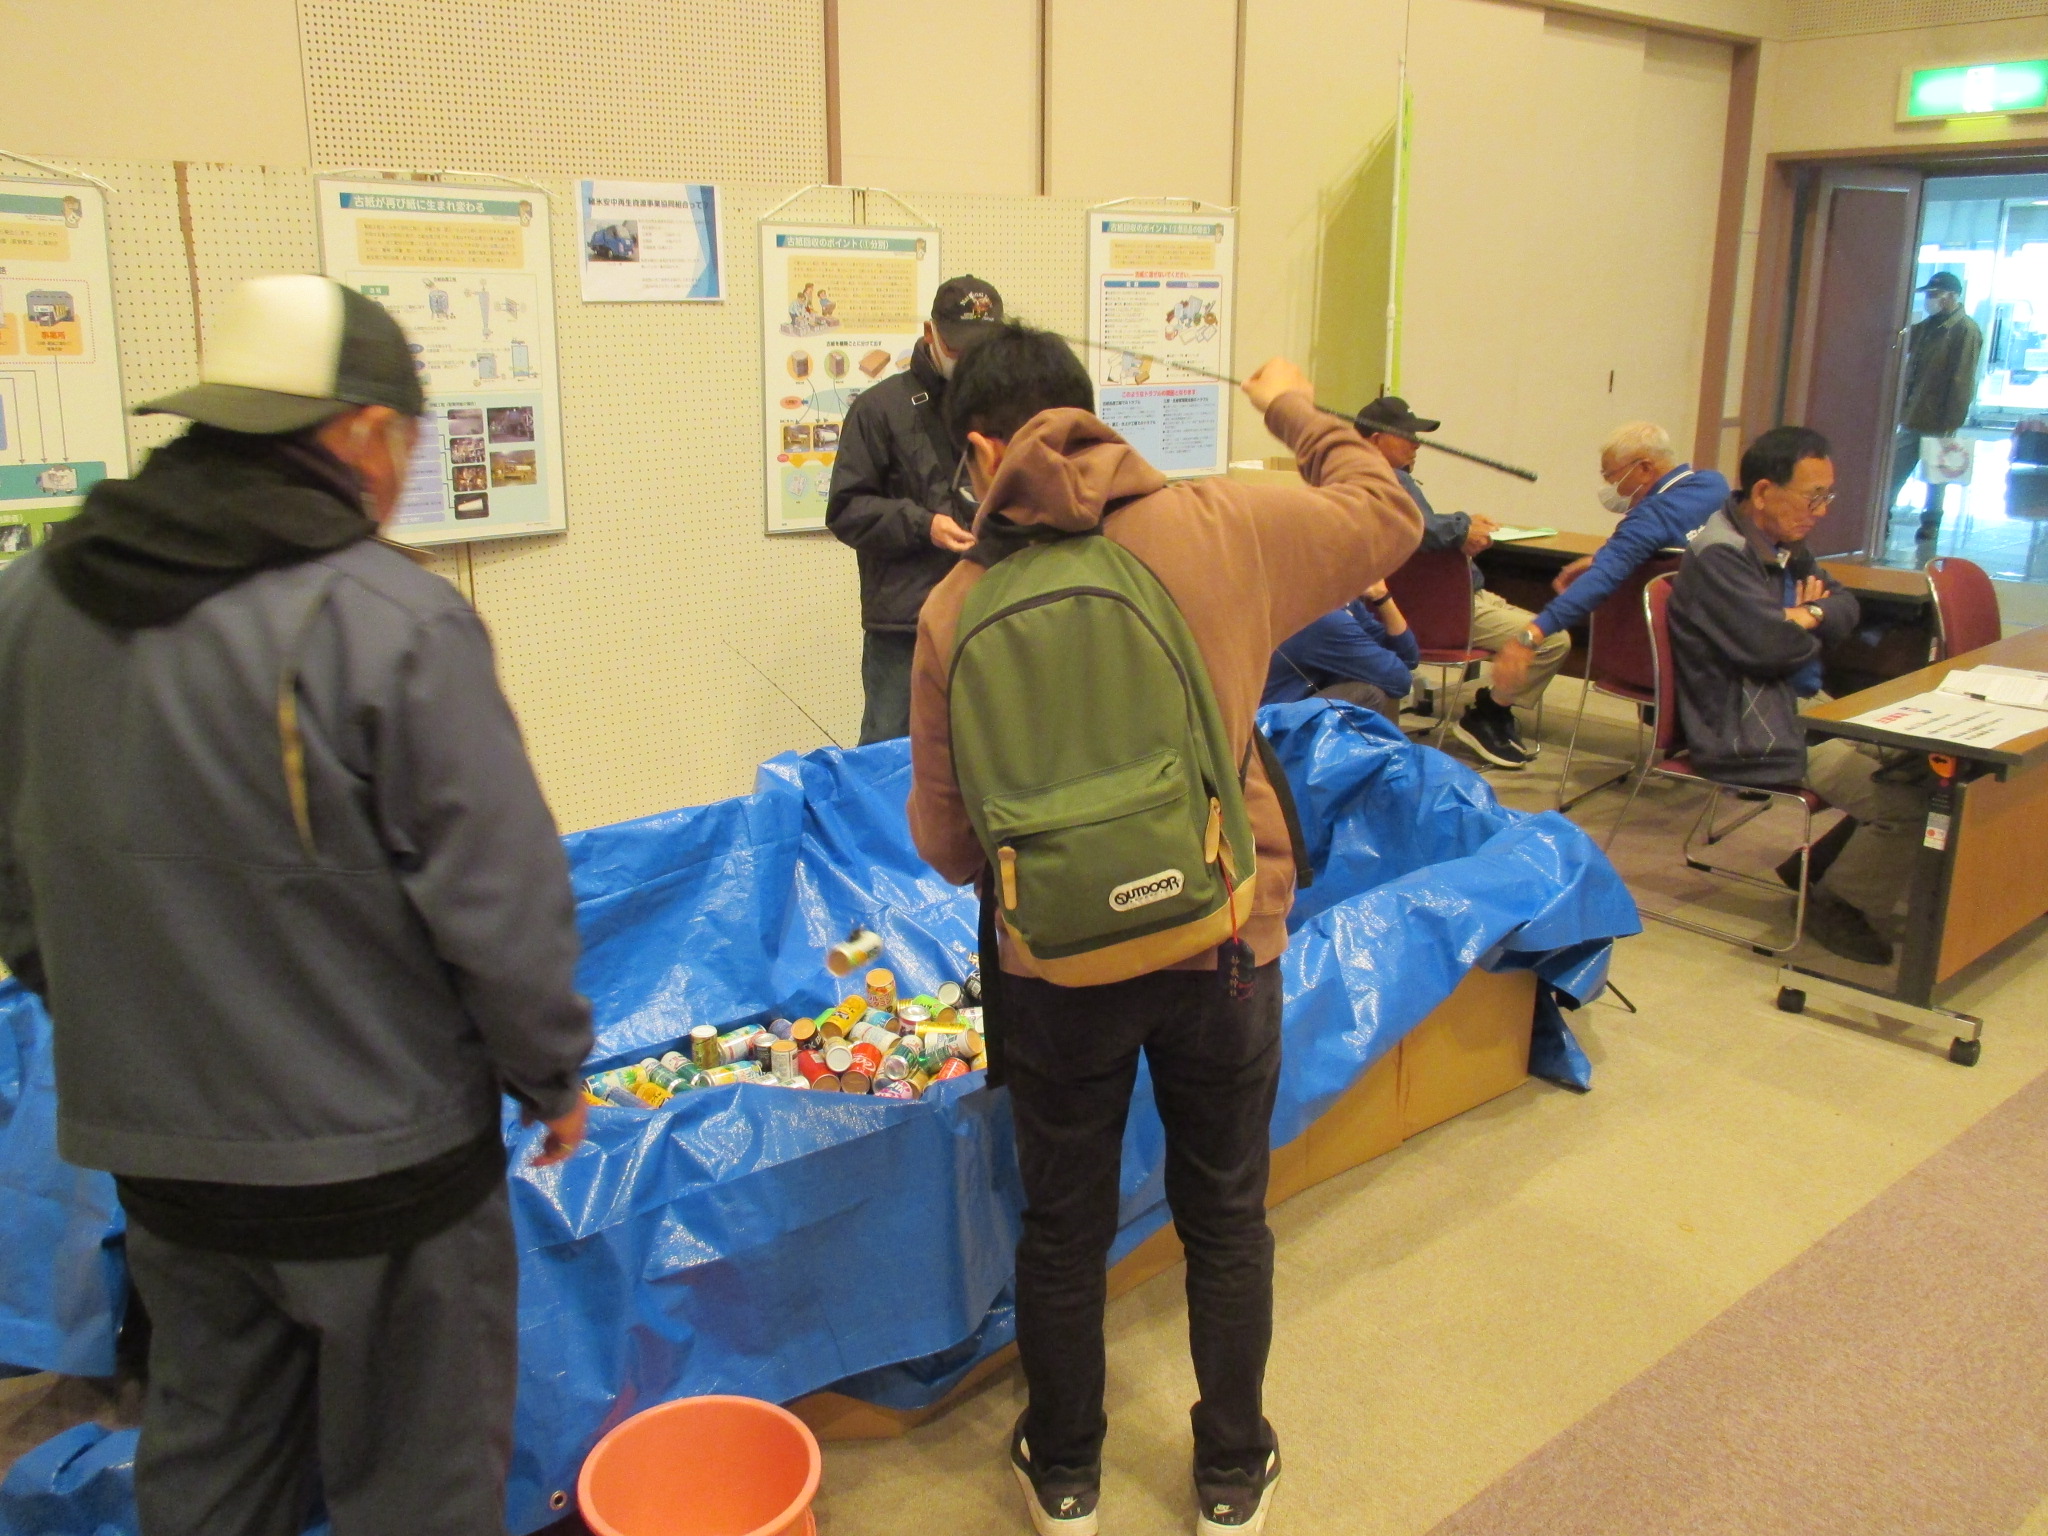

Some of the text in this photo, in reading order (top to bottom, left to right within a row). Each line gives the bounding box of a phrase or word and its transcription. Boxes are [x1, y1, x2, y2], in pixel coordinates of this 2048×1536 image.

[354, 196, 485, 213] 古紙が再び紙に生まれ変わる
[1114, 876, 1179, 905] OUTDOOR
